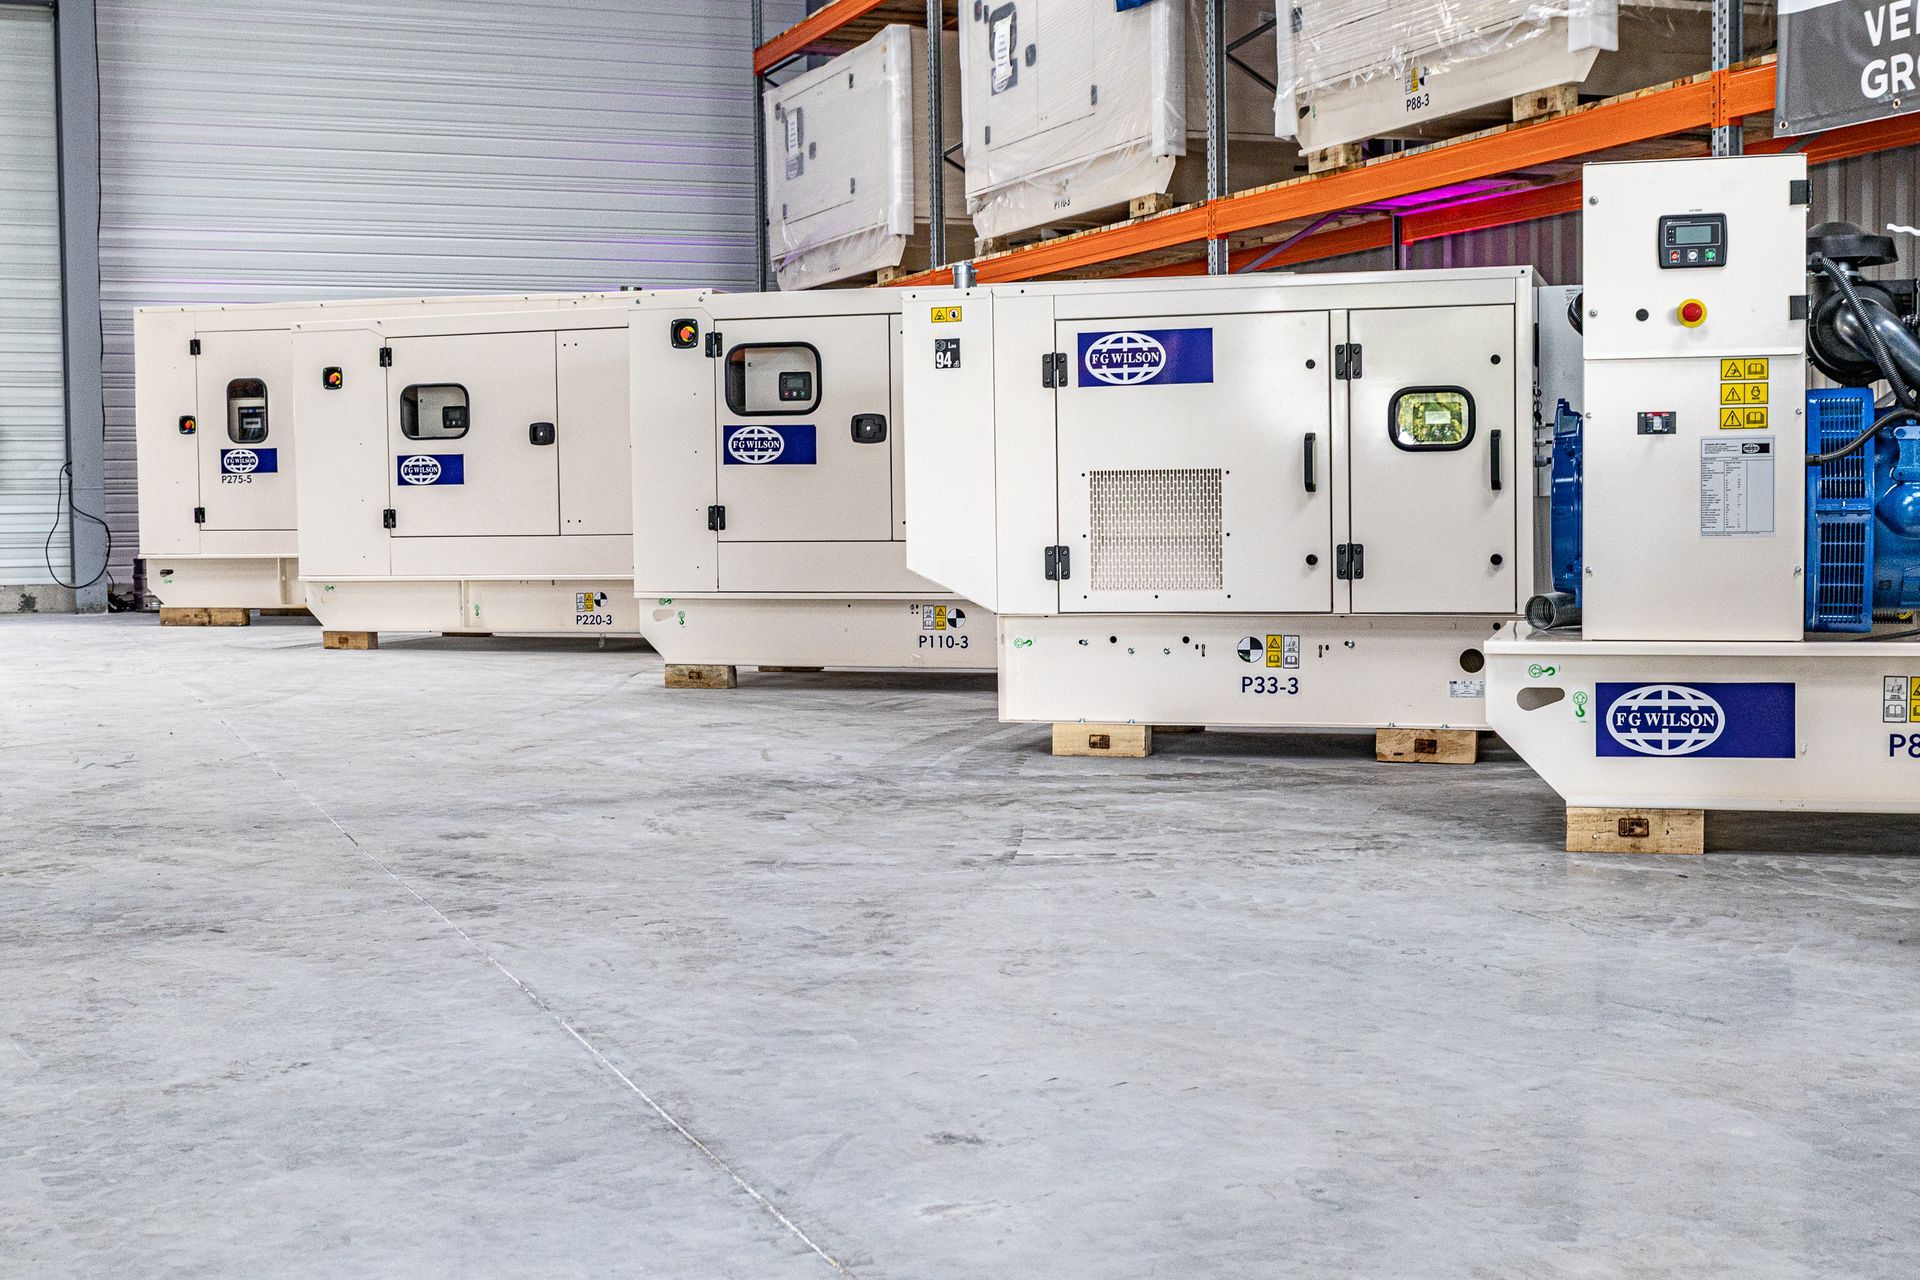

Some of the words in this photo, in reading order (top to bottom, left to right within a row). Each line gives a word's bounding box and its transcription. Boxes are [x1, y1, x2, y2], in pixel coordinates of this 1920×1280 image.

[1861, 53, 1920, 99] GR
[1406, 93, 1430, 112] P88-3
[936, 351, 952, 369] 94
[1091, 353, 1109, 365] FG
[1110, 351, 1160, 364] WILSON
[733, 440, 745, 449] FG
[746, 440, 780, 449] WILSON
[221, 475, 252, 484] P275-5
[576, 614, 612, 625] P220-3
[919, 635, 969, 649] P110-3
[1241, 676, 1299, 695] P33-3
[1616, 712, 1641, 727] FG
[1644, 712, 1716, 727] WILSON
